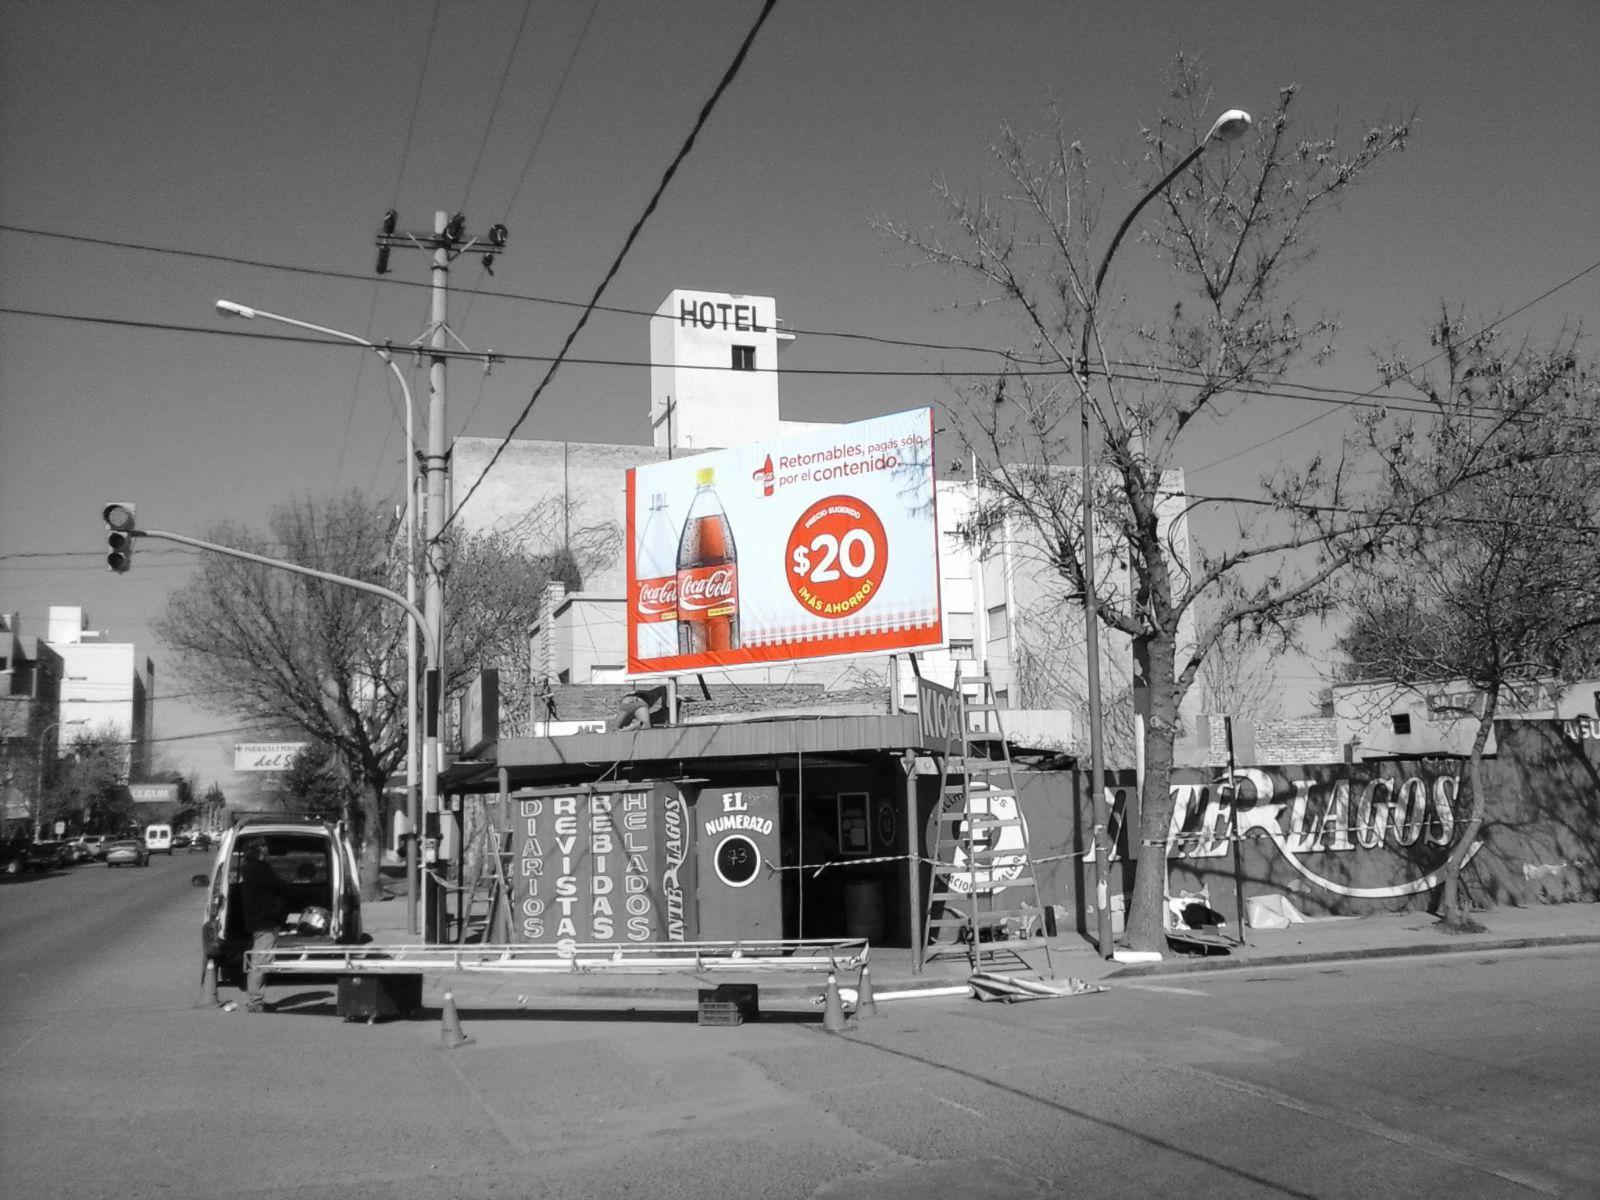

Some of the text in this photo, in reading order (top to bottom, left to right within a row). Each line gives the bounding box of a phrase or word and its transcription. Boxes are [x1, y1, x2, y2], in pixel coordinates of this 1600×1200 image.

[680, 299, 767, 333] HOTEL
[779, 444, 866, 470] Retornables,
[868, 439, 898, 455] pagás
[779, 473, 799, 488] por
[801, 471, 811, 482] el
[793, 528, 875, 583] $20
[681, 569, 733, 599] Coca-Cola
[722, 792, 748, 812] EL
[705, 814, 773, 836] NUMERAZO
[520, 799, 545, 938] DIARIOS
[590, 795, 615, 940] BEBIDAS
[623, 793, 651, 941] HELADOS
[728, 847, 748, 866] 73
[553, 797, 578, 959] REVISTAS
